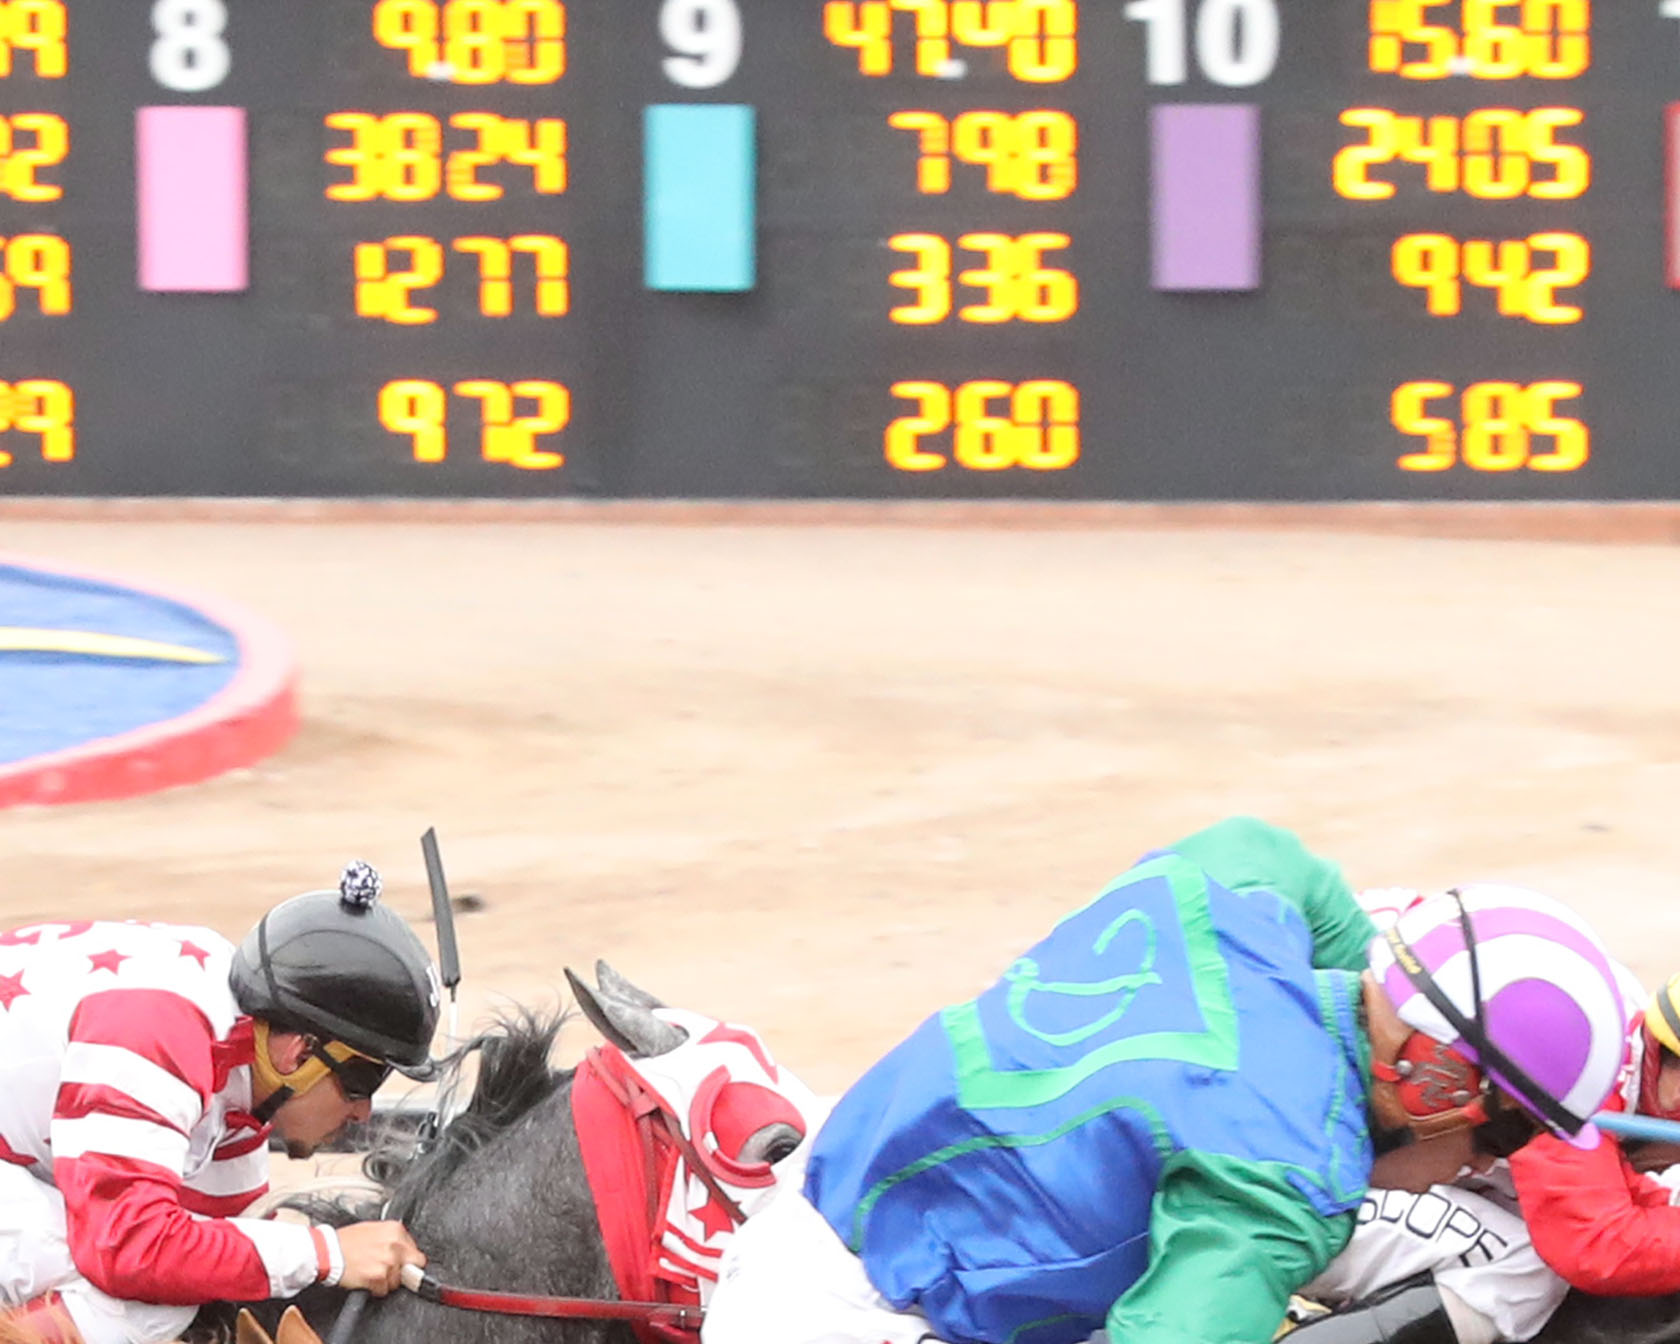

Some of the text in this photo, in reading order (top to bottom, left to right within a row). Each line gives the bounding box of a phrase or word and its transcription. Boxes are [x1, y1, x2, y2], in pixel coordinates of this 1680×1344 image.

[148, 0, 231, 92] 8
[658, 0, 743, 88] 9
[1124, 0, 1280, 87] 10
[324, 111, 567, 202] 3824
[888, 108, 1078, 201] 798
[1332, 105, 1592, 200] 2405
[354, 234, 569, 325] 1277
[888, 231, 1079, 325] 336
[1391, 230, 1592, 325] 942
[377, 378, 571, 470] 972
[884, 379, 1080, 472] 260
[1390, 379, 1590, 472] 585
